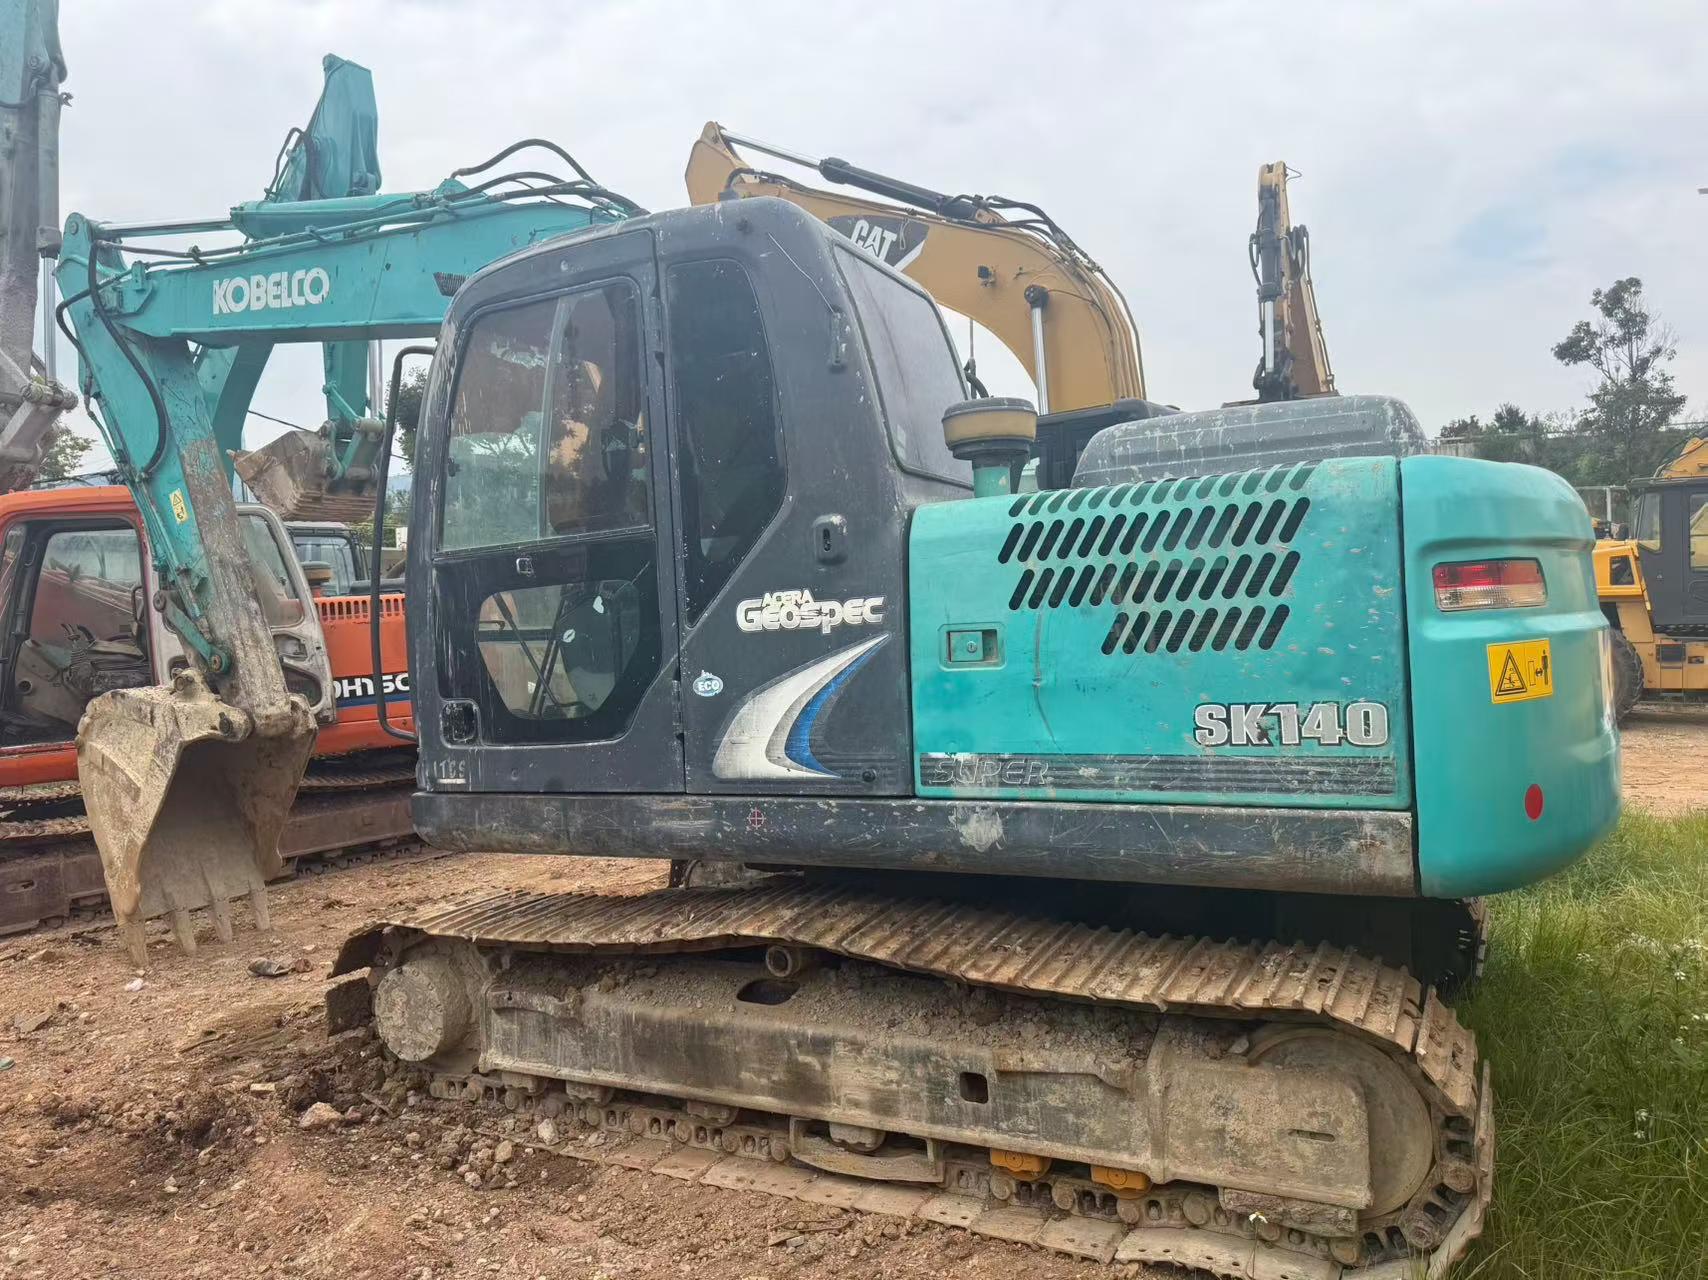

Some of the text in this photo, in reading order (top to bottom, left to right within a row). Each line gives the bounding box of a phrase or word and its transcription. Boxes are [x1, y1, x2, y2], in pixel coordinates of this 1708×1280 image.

[850, 219, 898, 261] CAT
[212, 267, 330, 315] KOBELCO
[697, 680, 720, 691] ECO
[1194, 702, 1388, 746] SK140
[927, 758, 1049, 785] SUPER
